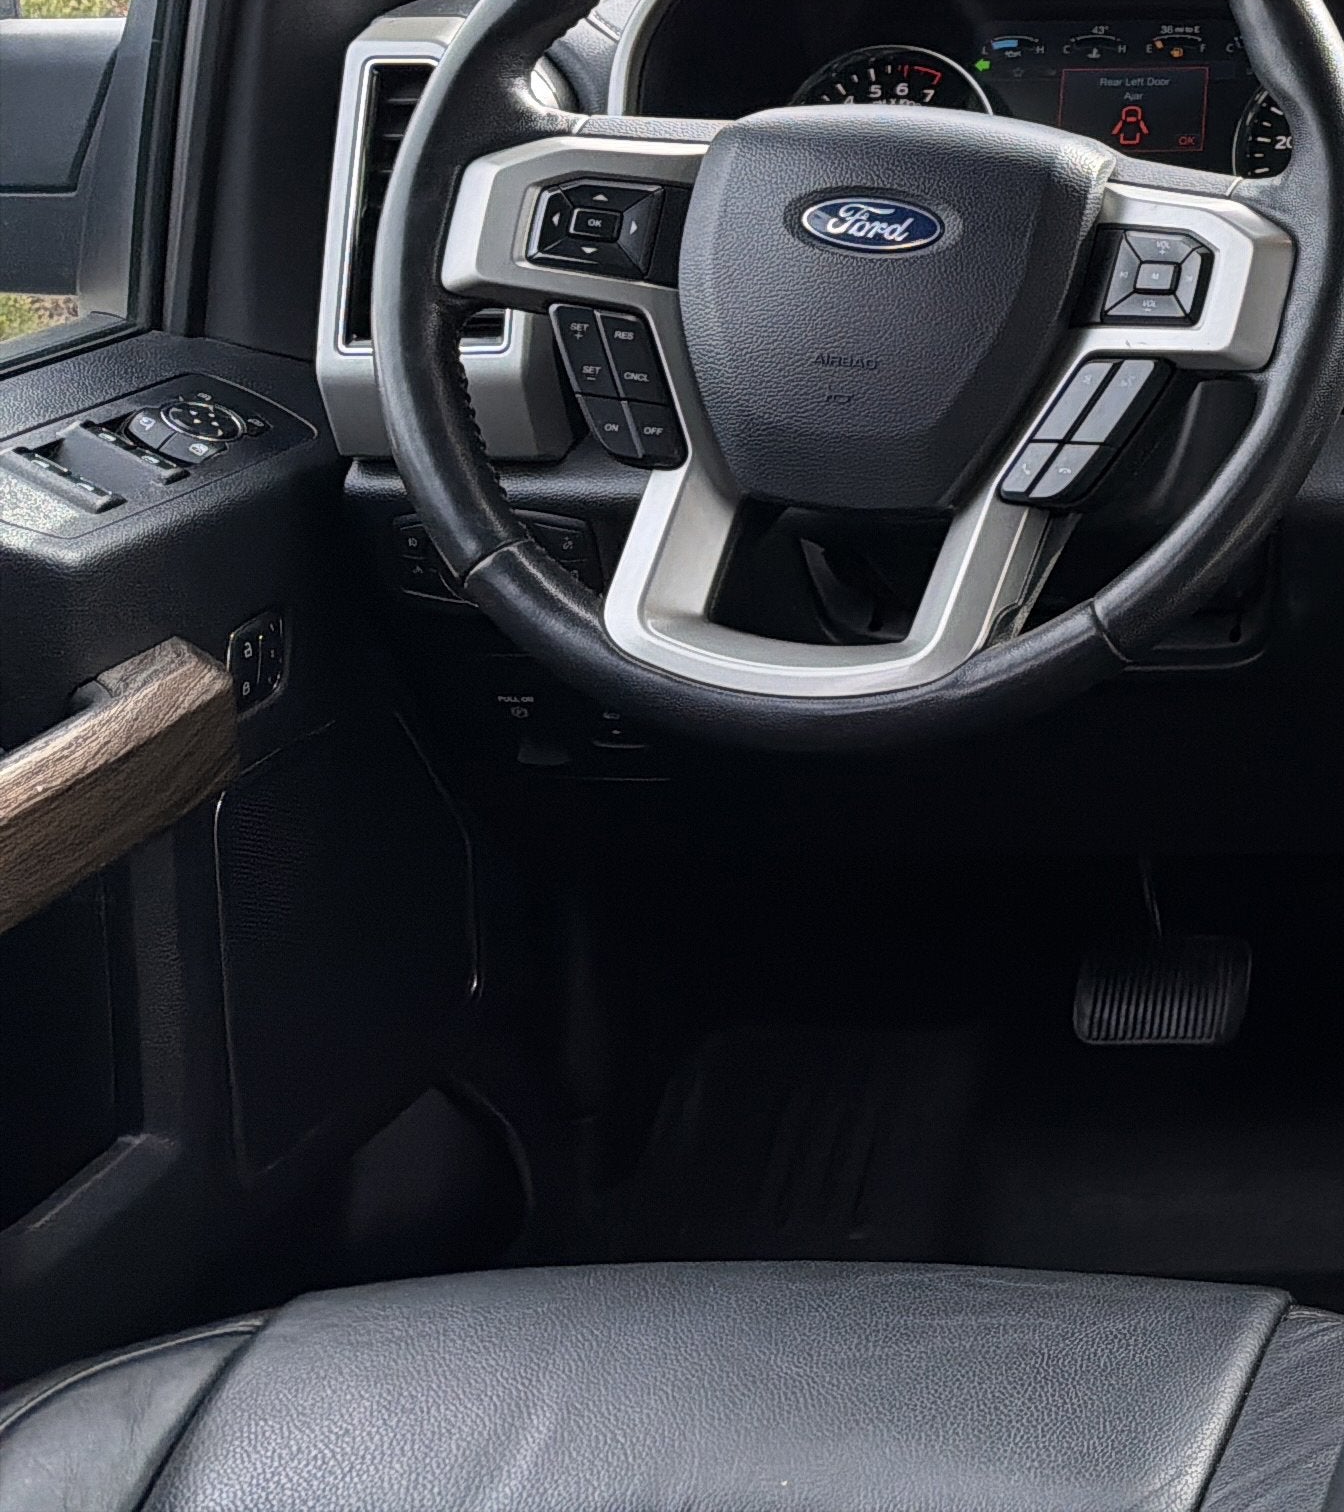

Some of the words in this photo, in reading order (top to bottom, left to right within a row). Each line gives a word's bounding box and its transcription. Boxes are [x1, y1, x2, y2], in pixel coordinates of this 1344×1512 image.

[1035, 46, 1045, 54] H
[1063, 45, 1071, 54] C
[1118, 45, 1127, 54] H
[1146, 45, 1153, 54] E
[1100, 77, 1123, 86] Rear
[1126, 77, 1144, 86] Left
[1147, 77, 1171, 86] Door
[869, 85, 882, 98] 5
[896, 83, 909, 96] 6
[923, 90, 935, 102] 7
[1124, 91, 1143, 101] Ajar
[1178, 136, 1196, 145] OK
[588, 218, 602, 228] OK
[826, 202, 915, 242] Ford
[1156, 240, 1170, 249] VOL
[1143, 299, 1156, 308] VOL
[570, 322, 589, 332] SET
[614, 330, 634, 340] RES
[582, 365, 601, 375] SET
[623, 371, 650, 382] CNCL
[604, 423, 619, 432] ON
[644, 426, 663, 435] OFF
